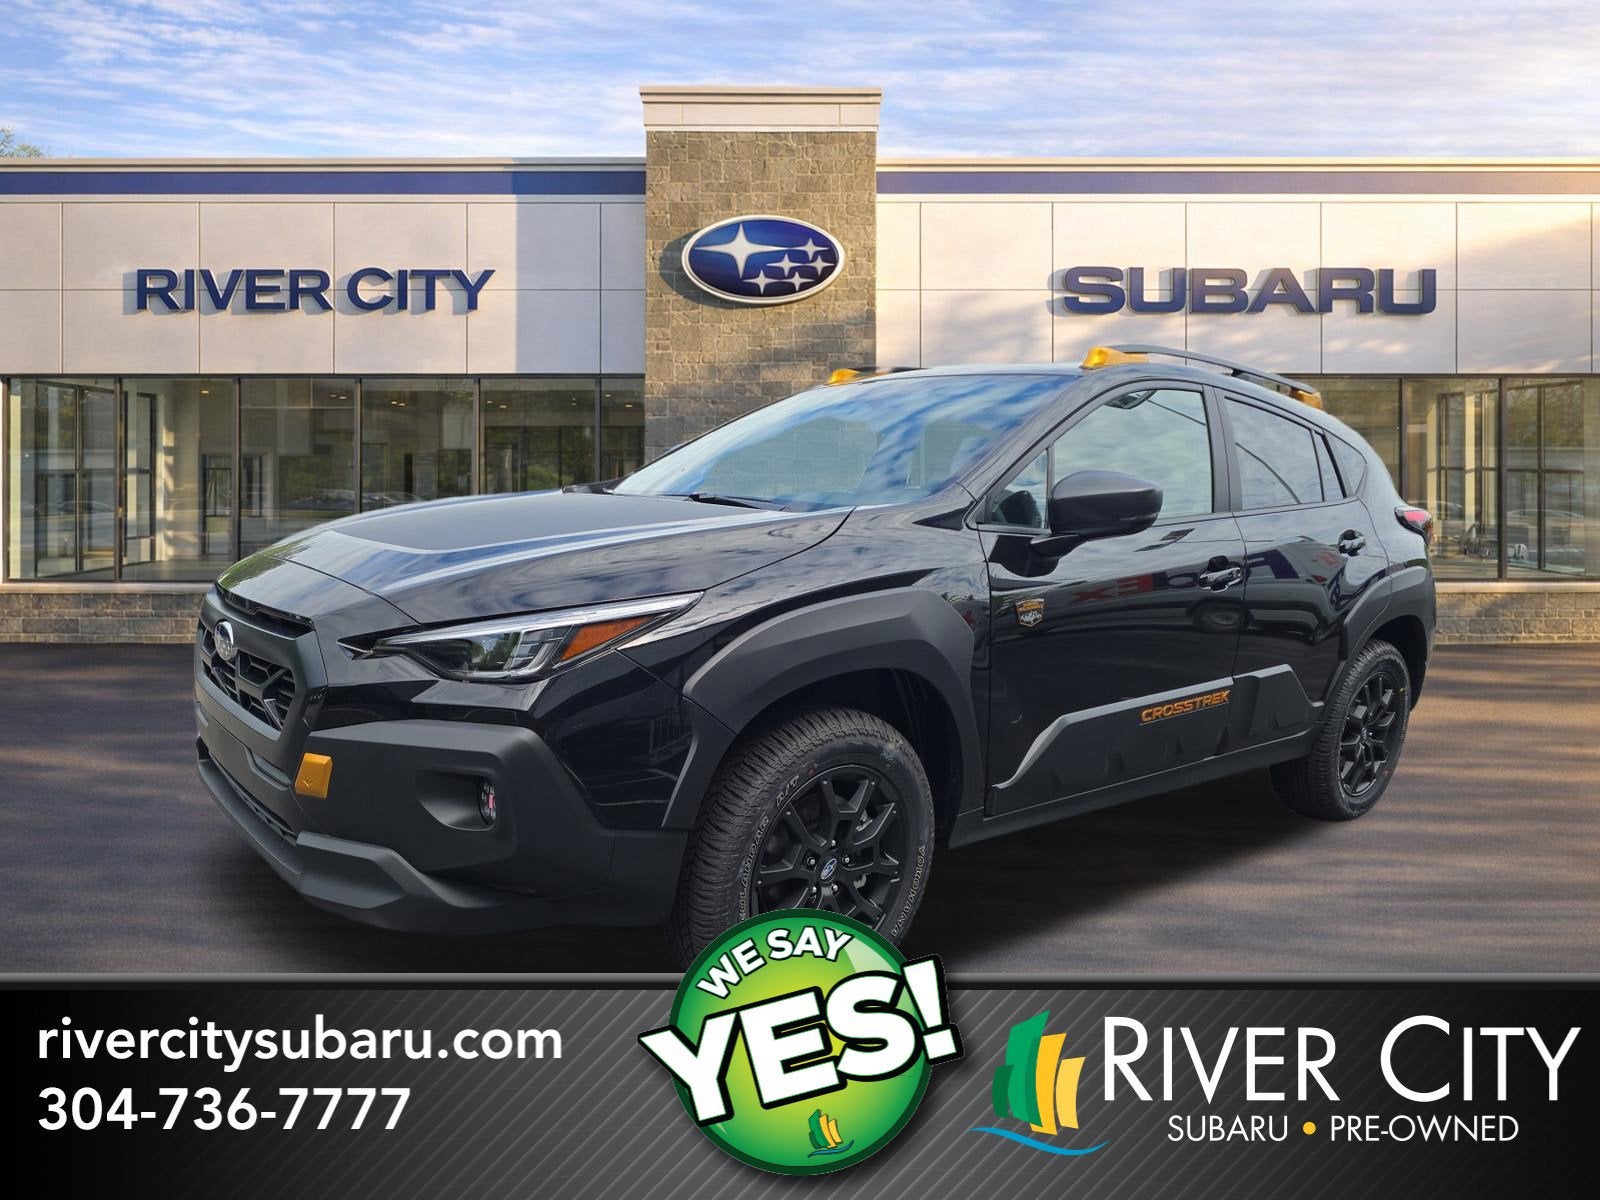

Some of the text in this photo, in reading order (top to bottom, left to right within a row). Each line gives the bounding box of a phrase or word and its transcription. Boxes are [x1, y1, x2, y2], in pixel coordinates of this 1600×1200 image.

[136, 267, 496, 312] RIVER CITY
[1063, 266, 1437, 316] SUBARU
[1140, 690, 1230, 723] CROSSTREK
[891, 845, 927, 938] YOKOHAMA
